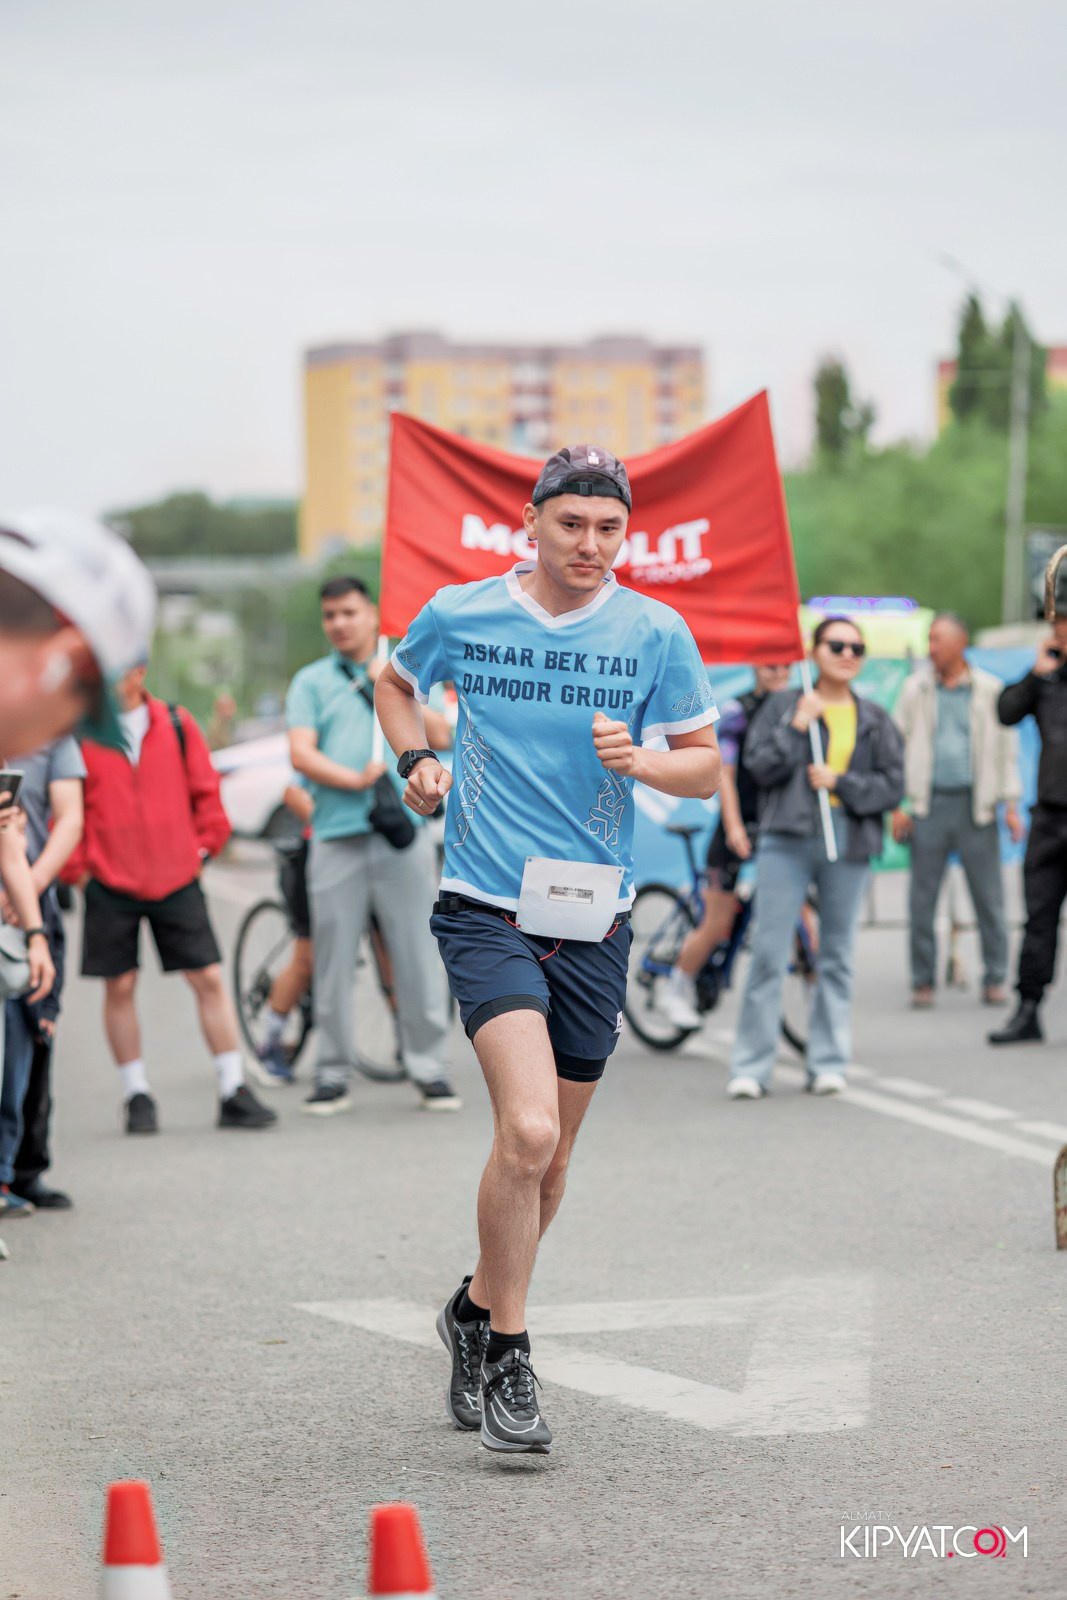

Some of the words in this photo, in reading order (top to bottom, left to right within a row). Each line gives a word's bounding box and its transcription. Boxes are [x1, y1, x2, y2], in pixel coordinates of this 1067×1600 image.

[461, 513, 711, 569] MOLIT
[463, 643, 535, 668] ASKAR
[544, 650, 588, 673] BEK
[597, 656, 638, 677] TAU
[462, 673, 552, 702] QAMQOR
[560, 685, 634, 709] GROUP
